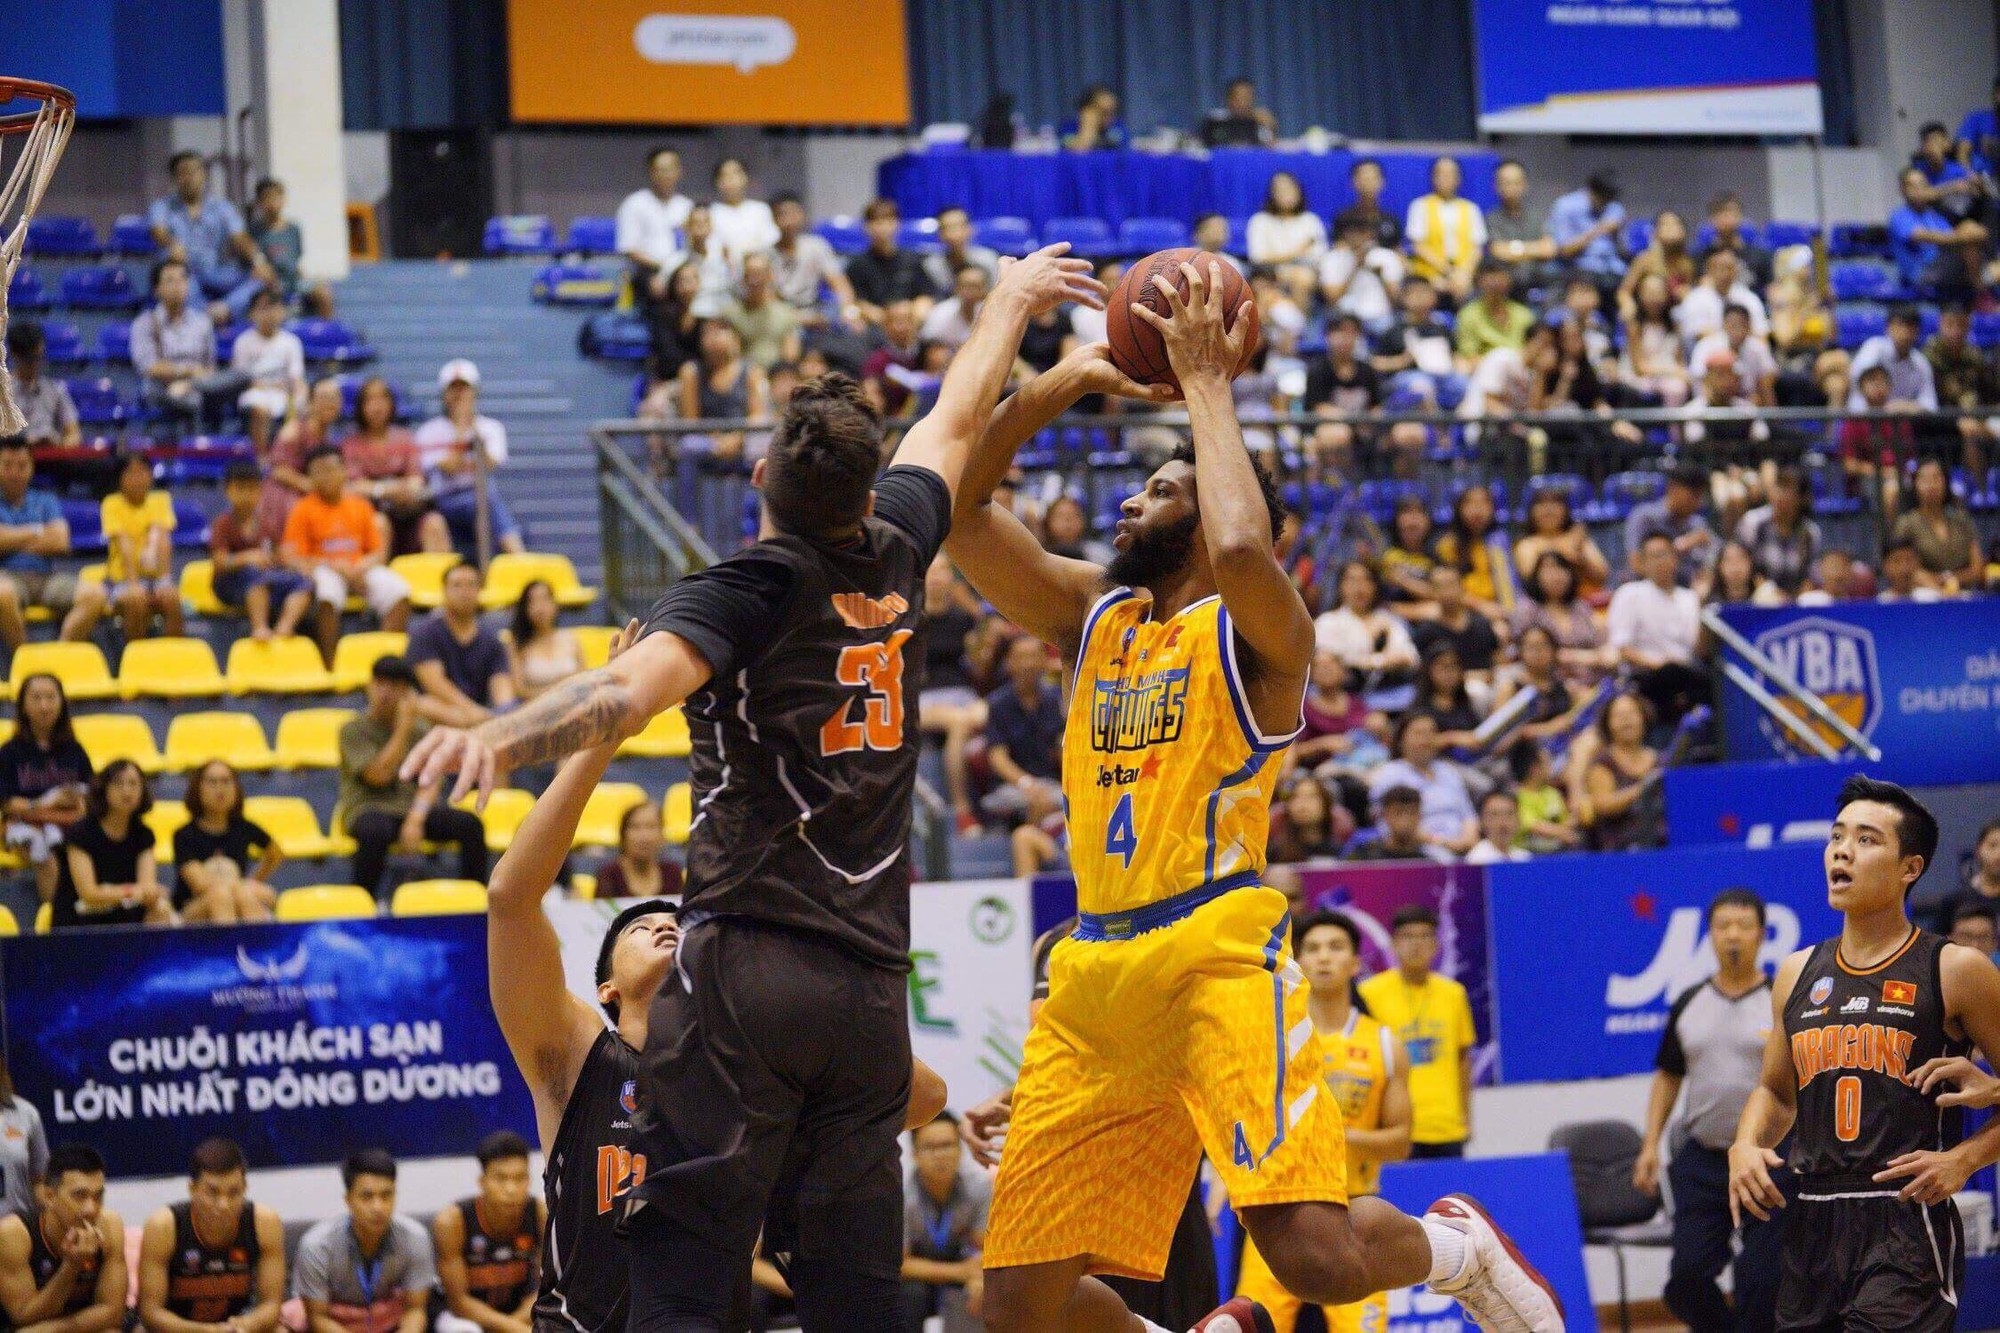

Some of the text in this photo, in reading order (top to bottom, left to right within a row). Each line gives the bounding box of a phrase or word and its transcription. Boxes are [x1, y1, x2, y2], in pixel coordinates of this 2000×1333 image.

[1105, 791, 1139, 870] 4
[108, 1020, 443, 1073] CHUỖI KHÁCH SẠN
[1791, 1022, 1917, 1091] DRAGONS
[54, 1061, 501, 1122] LỚN NHẤT ĐÔNG DƯƠNG
[1835, 1076, 1862, 1142] 0
[1233, 1120, 1255, 1172] 4
